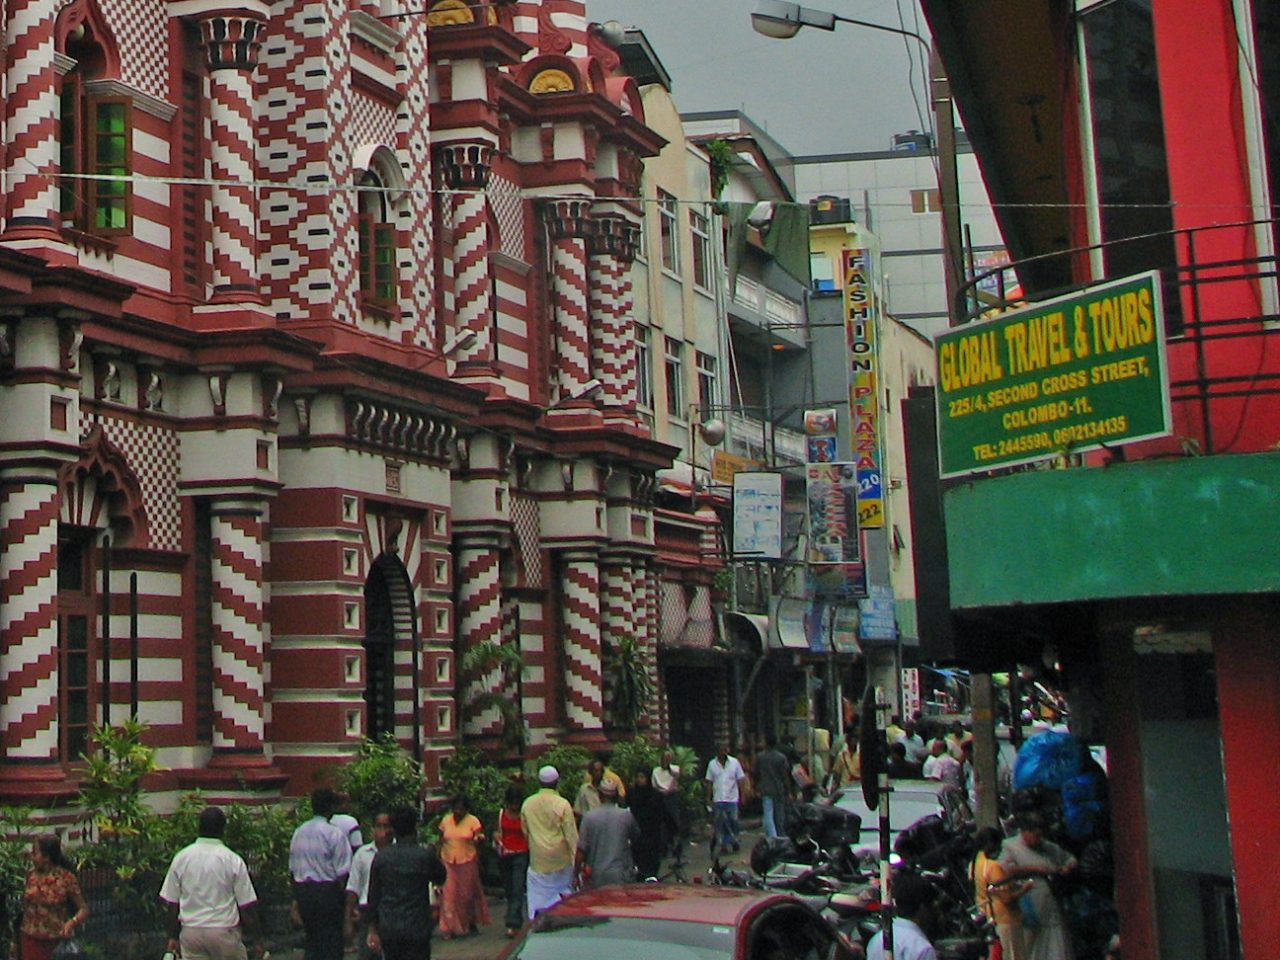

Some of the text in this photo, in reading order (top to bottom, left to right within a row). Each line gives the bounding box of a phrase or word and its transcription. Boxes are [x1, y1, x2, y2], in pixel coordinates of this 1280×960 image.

[849, 256, 877, 468] FASHION PLAZA
[940, 287, 1154, 392] GLOBAL TRAVEL & TOURS
[1041, 370, 1089, 395] CROSS
[1091, 356, 1151, 385] STREET,
